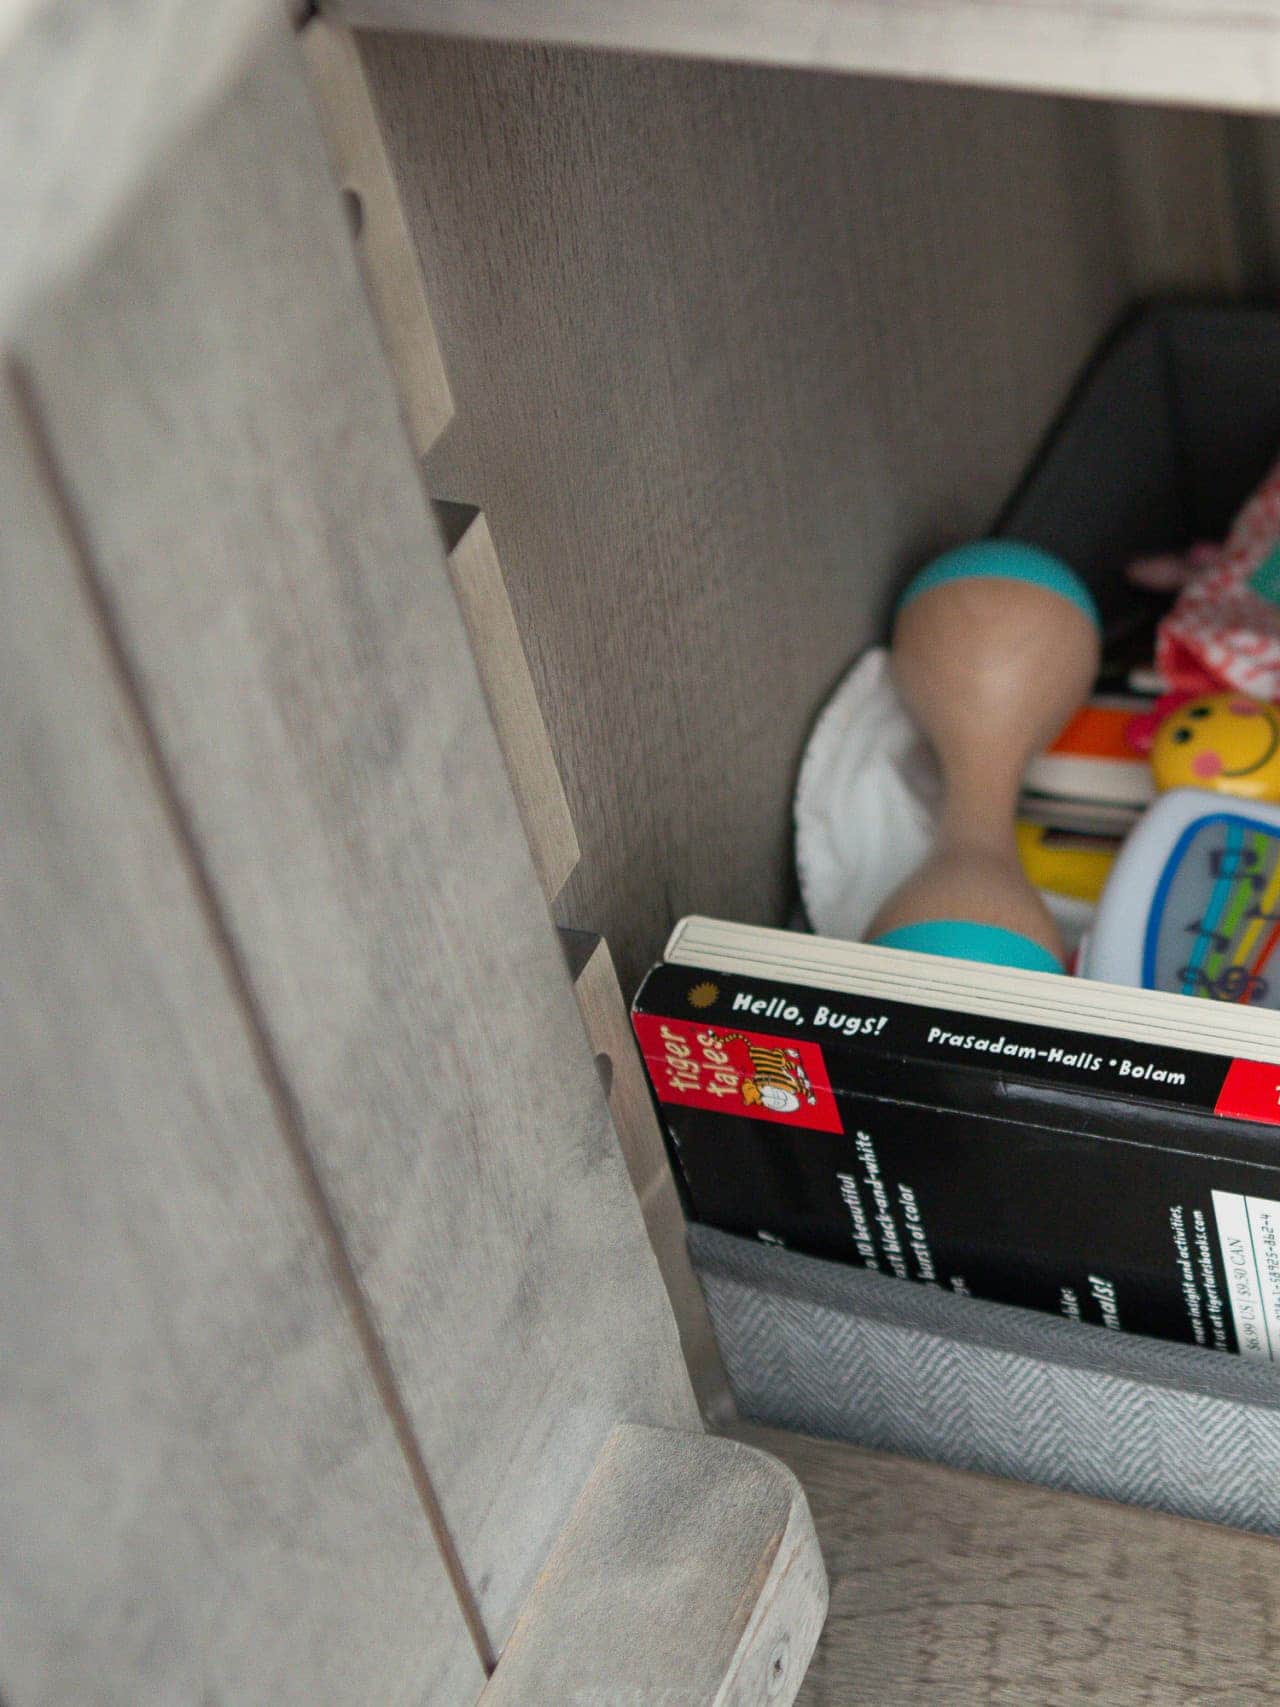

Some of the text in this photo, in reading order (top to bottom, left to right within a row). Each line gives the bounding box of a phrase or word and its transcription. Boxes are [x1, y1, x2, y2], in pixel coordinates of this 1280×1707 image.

[732, 992, 888, 1036] Hello, Bugs!
[660, 1024, 701, 1092] tiger
[697, 1032, 740, 1097] tales
[927, 1027, 1186, 1085] Prasadam-Halls Bolam
[837, 1173, 872, 1241] beautiful
[856, 1131, 901, 1252] black-and-white
[858, 1242, 875, 1257] 10
[898, 1183, 935, 1280] burst of color
[1169, 1205, 1189, 1259] activities,
[1227, 1236, 1247, 1265] CAN
[1177, 1260, 1194, 1281] and
[1193, 1210, 1222, 1313] tigertalesbooks.com
[1234, 1267, 1252, 1296] $9.50
[1182, 1282, 1201, 1319] insight
[1211, 1312, 1224, 1328] at
[1240, 1305, 1256, 1320] US
[1214, 1329, 1227, 1342] us
